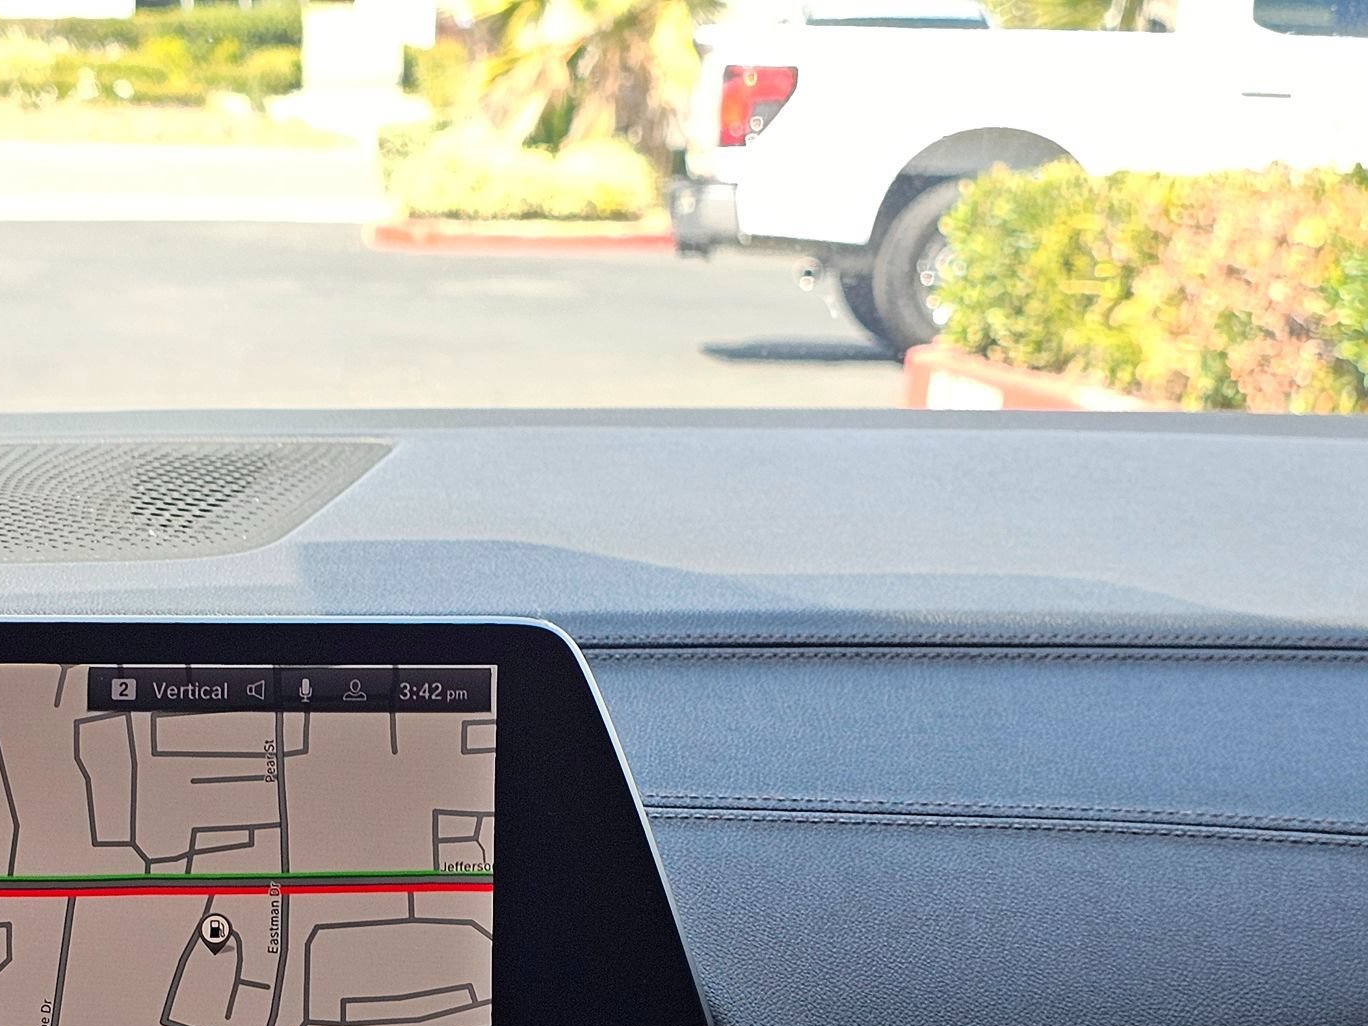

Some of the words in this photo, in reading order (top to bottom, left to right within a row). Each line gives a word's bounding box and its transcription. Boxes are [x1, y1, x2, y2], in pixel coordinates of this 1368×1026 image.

[117, 682, 130, 698] 2
[152, 681, 229, 700] Vertical
[399, 682, 443, 700] 3:42
[446, 687, 468, 703] pm
[264, 752, 276, 783] Pear
[440, 861, 492, 873] Jefferso
[267, 900, 280, 954] Eastman
[40, 998, 52, 1014] Dr
